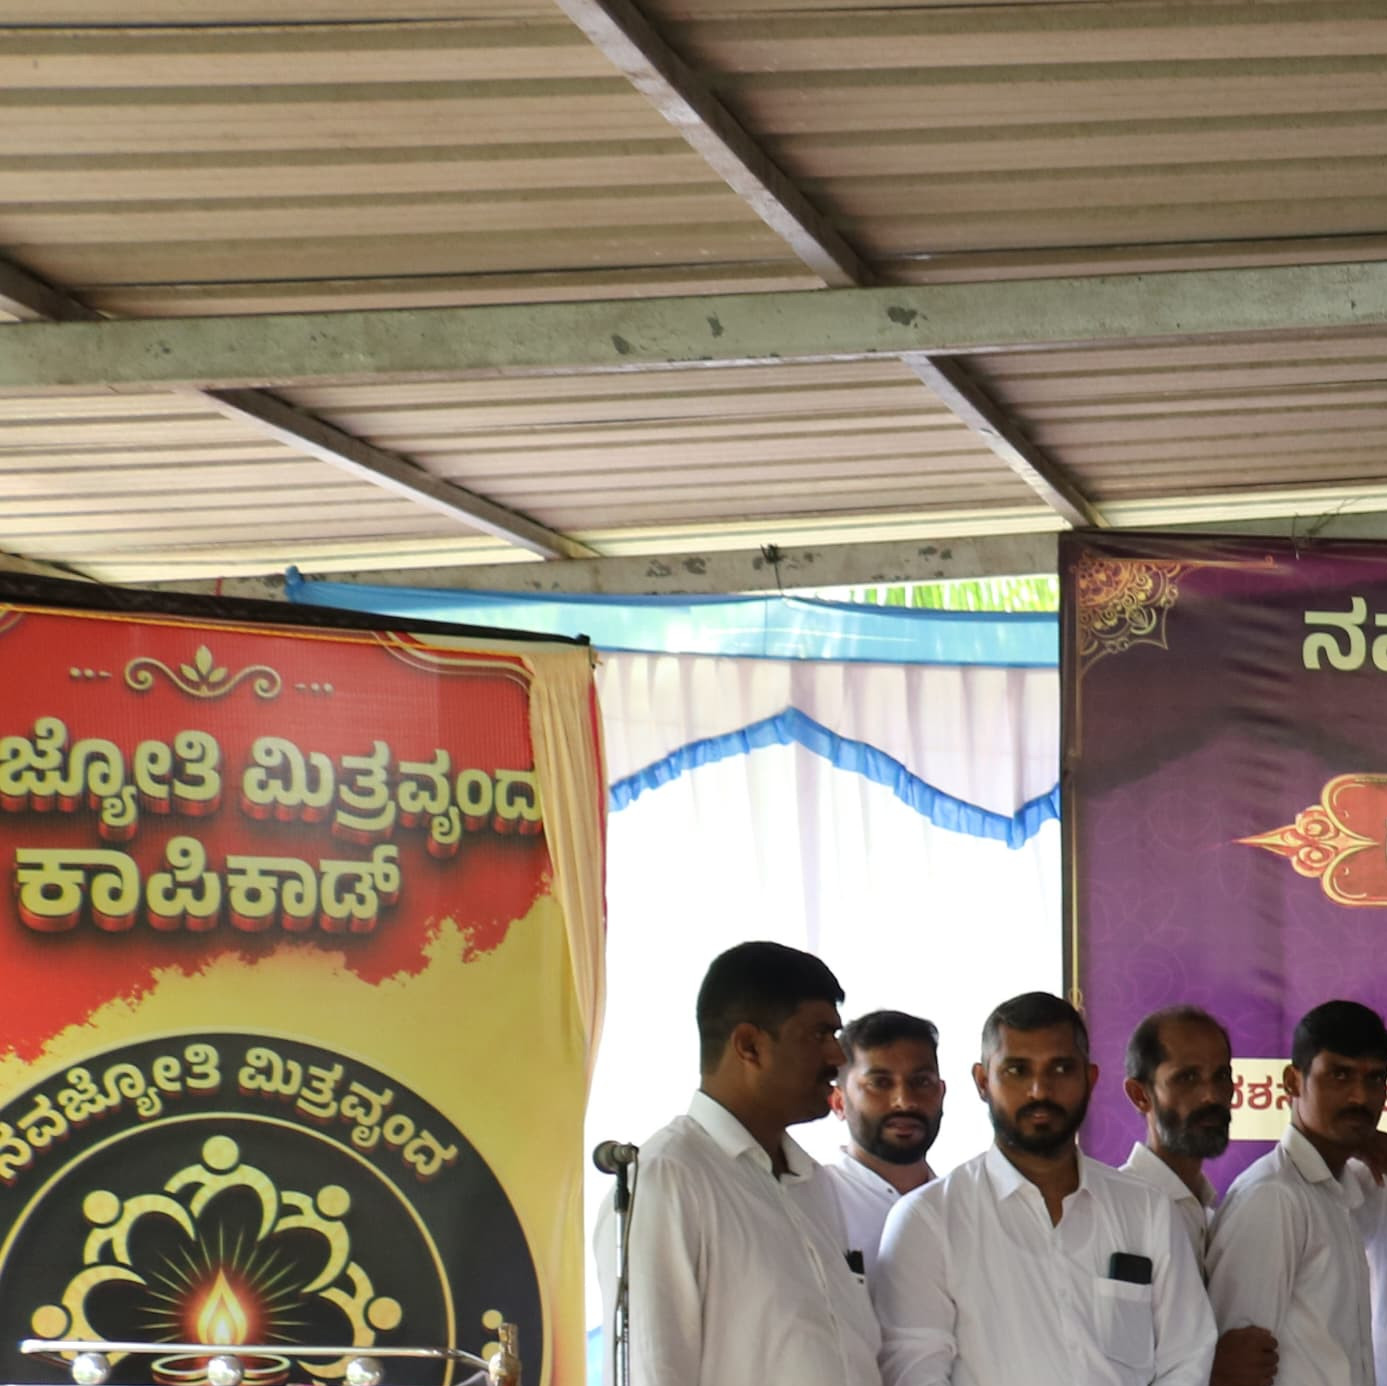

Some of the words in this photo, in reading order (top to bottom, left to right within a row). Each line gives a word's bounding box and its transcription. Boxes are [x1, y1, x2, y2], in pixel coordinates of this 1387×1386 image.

[242, 734, 542, 846] ಮಿತ್ರವೃಂದ
[16, 836, 400, 921] ಕಾಪಿಕಾಡ್
[239, 1046, 459, 1177] ಮಿತ್ರವೃಂದ
